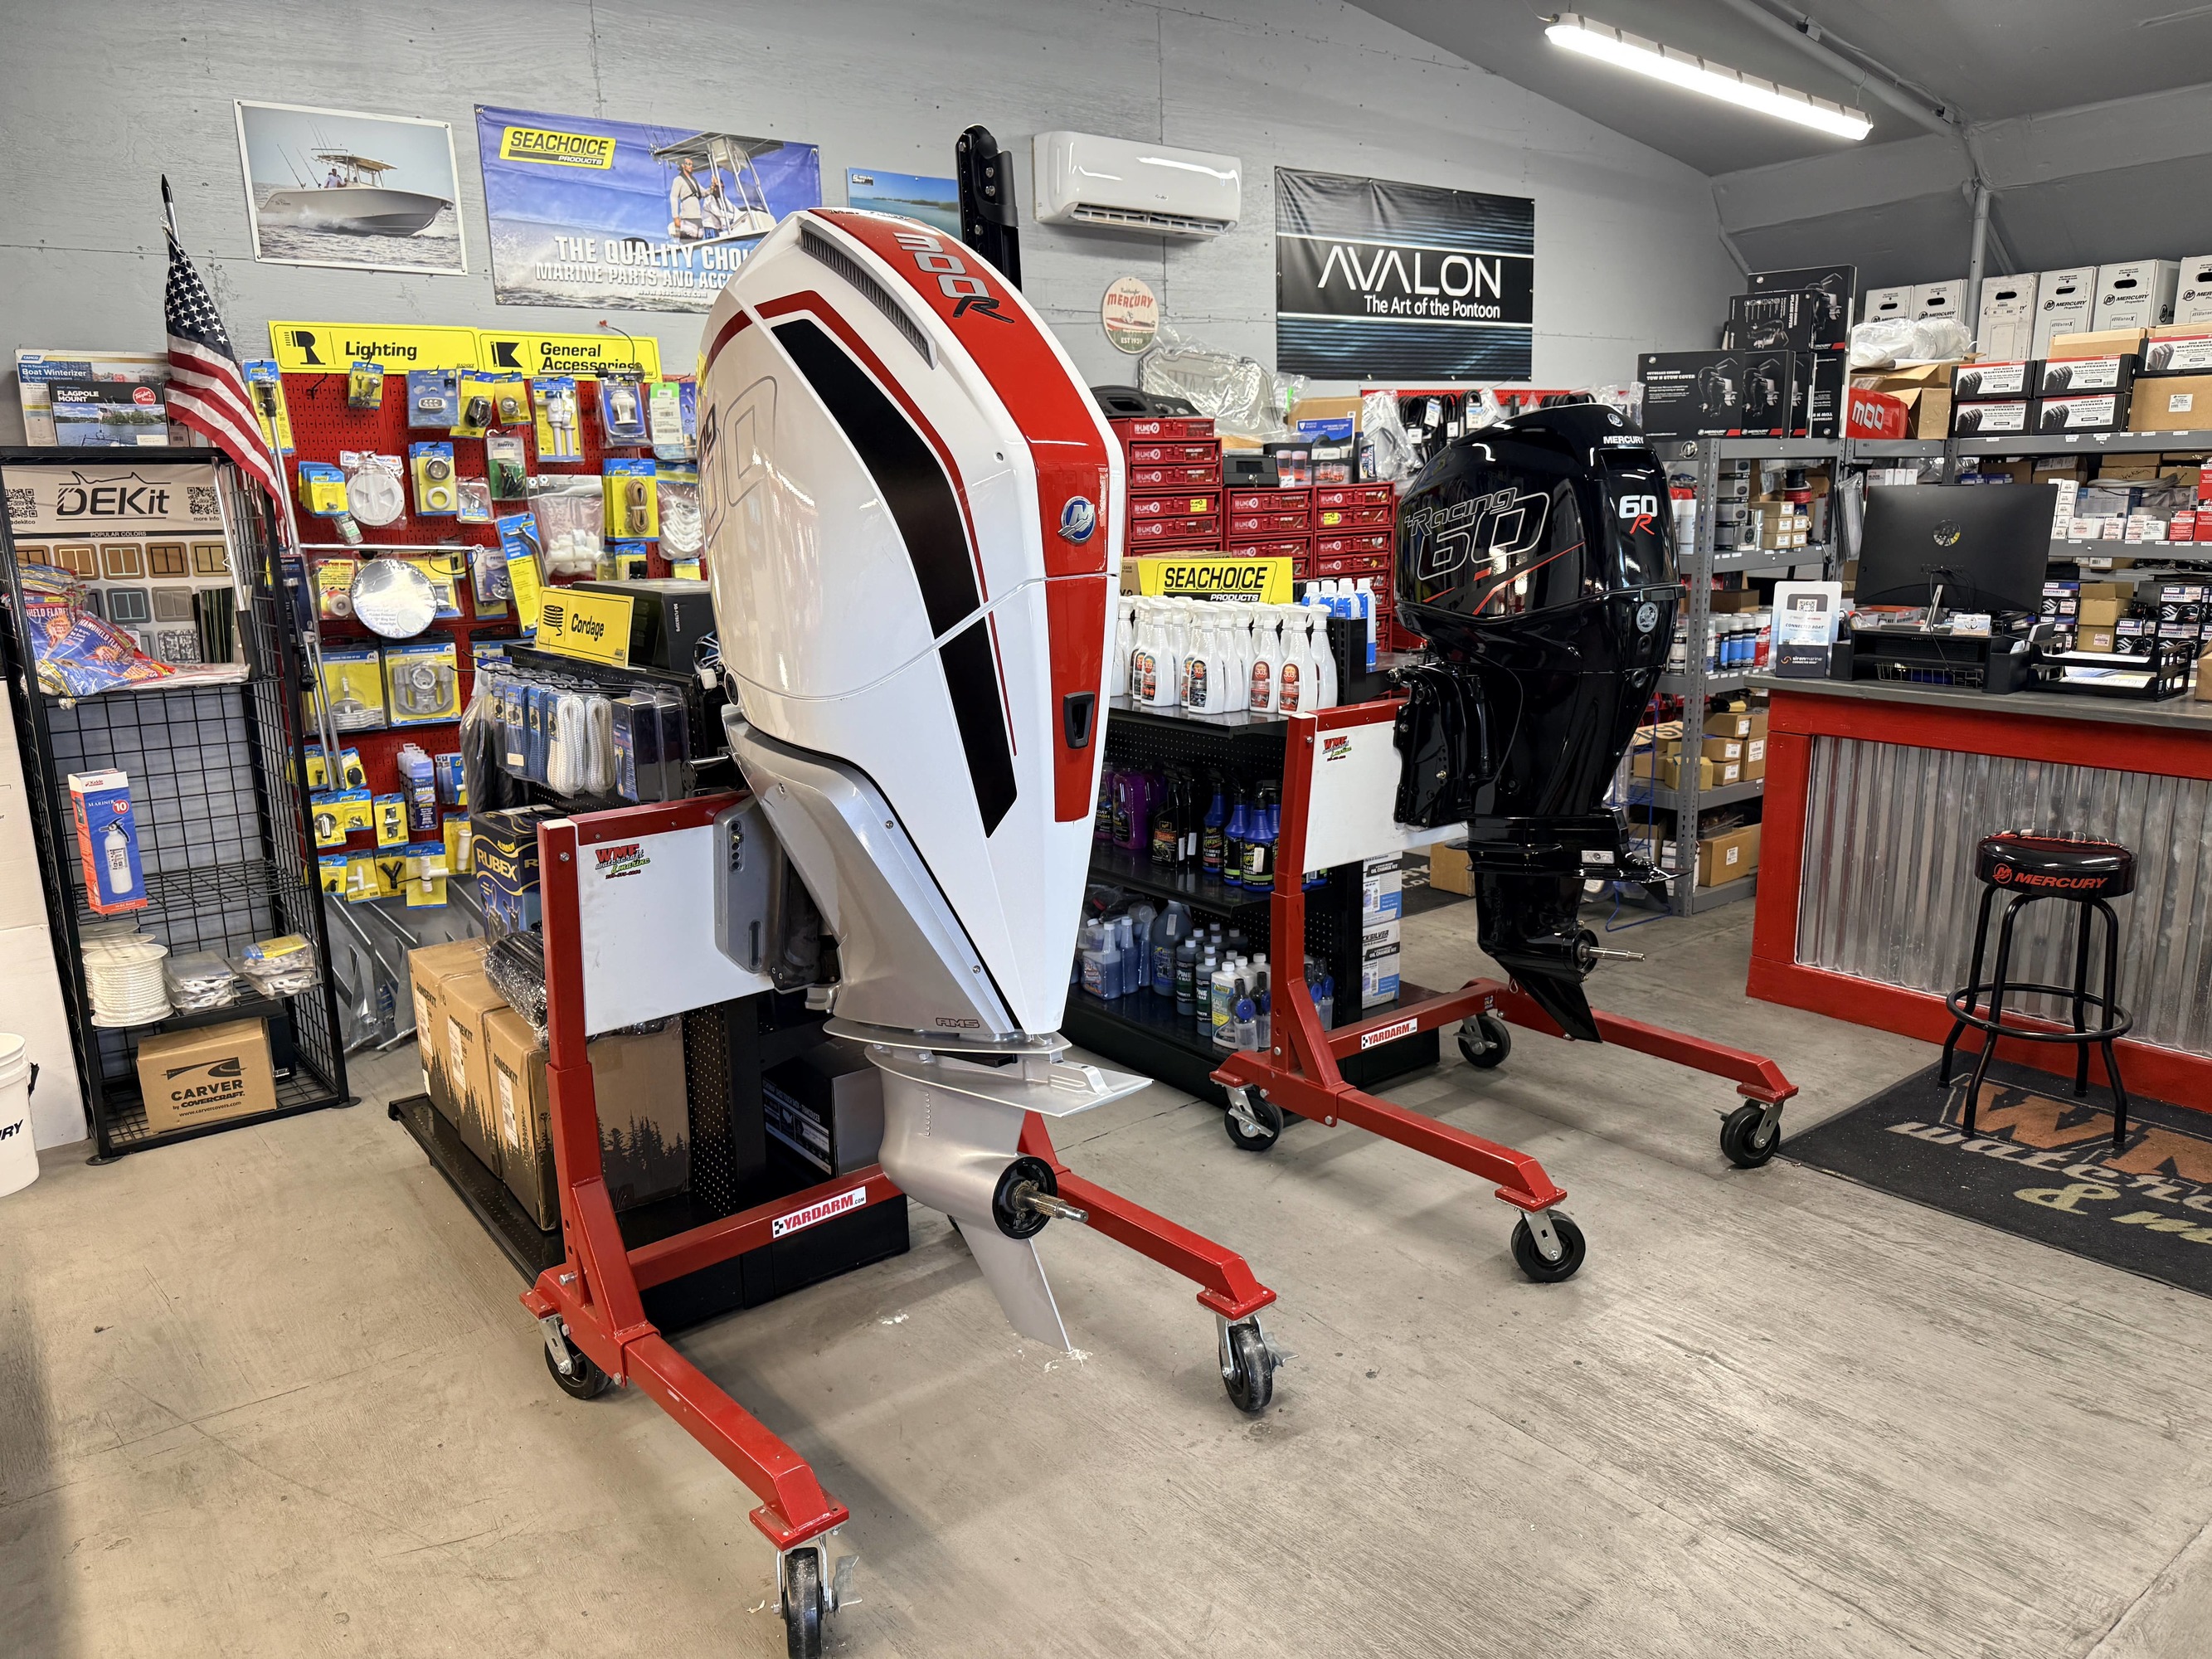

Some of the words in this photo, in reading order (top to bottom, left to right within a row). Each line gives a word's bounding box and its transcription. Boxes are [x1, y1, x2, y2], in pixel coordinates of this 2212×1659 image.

[509, 130, 610, 157] SEACHOICE
[558, 154, 604, 165] PRODUCTS
[554, 236, 598, 265] THE
[605, 237, 696, 269] QUALITY
[535, 262, 604, 285] MARINE
[608, 264, 658, 287] PARTS
[663, 267, 694, 289] AND
[1317, 245, 1501, 299] AVALON
[637, 288, 707, 299] www.seachoice.com
[1106, 293, 1154, 309] MERCURY
[2055, 299, 2088, 308] MERCURY
[2116, 294, 2150, 302] MERCURY
[1364, 294, 1388, 314] The
[1391, 296, 1411, 316] Art
[1414, 298, 1430, 316] of
[1430, 298, 1450, 317] the
[1452, 300, 1501, 319] Pontoon
[345, 341, 418, 360] Lighting
[540, 341, 601, 358] General
[542, 357, 636, 373] Accessories
[1851, 400, 1884, 431] 300
[1603, 435, 1645, 445] MERCURY
[56, 487, 170, 516] DEKit
[1407, 487, 1518, 538] Racing
[1619, 494, 1658, 519] 60
[1629, 513, 1655, 535] R
[1416, 491, 1550, 581] 60
[1164, 566, 1268, 590] SEACHOICE
[1210, 593, 1259, 602] PRODUCTS
[79, 619, 109, 641] HANDHELD
[571, 612, 605, 642] Cordage
[88, 800, 114, 808] MARINER
[114, 801, 127, 811] 10
[595, 843, 640, 864] WMF
[476, 847, 518, 883] RUBEX
[2014, 872, 2108, 889] MERCURY
[1363, 929, 1389, 942] CKSILVER
[416, 981, 437, 1008] RINSEKIT
[935, 1016, 980, 1029] AMS
[1367, 1024, 1411, 1046] YARDARM
[493, 1053, 518, 1085] RINSEKIT
[171, 1079, 243, 1102] CARVER
[178, 1101, 242, 1117] www.carvercovers.com
[783, 1193, 854, 1231] YARDARM
[854, 1197, 865, 1206] .COM
